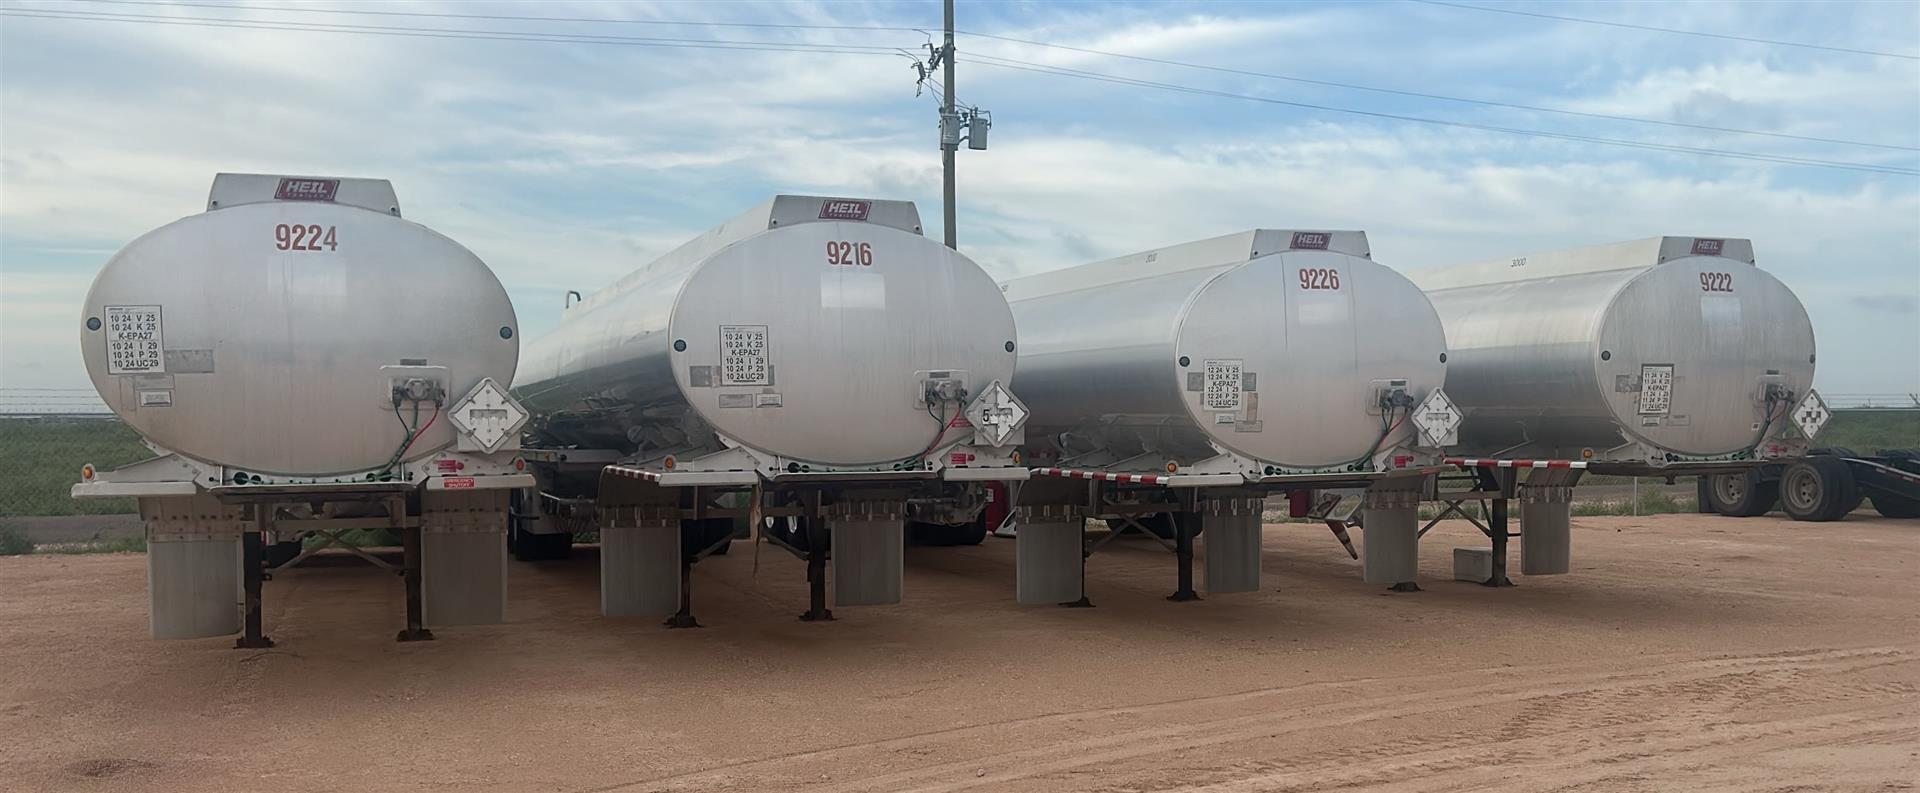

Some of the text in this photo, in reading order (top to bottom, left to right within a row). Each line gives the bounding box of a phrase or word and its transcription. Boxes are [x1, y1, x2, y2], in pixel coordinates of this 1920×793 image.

[287, 181, 327, 193] HEIL
[829, 202, 862, 214] HEIL
[275, 223, 338, 251] 9224
[1297, 234, 1324, 244] HEIL
[827, 241, 873, 266] 9216
[1299, 268, 1340, 290] 9226
[1700, 272, 1734, 292] 9222
[118, 332, 152, 340] K-EPA27
[112, 342, 158, 350] 10 24 I 29
[982, 409, 990, 422] 5
